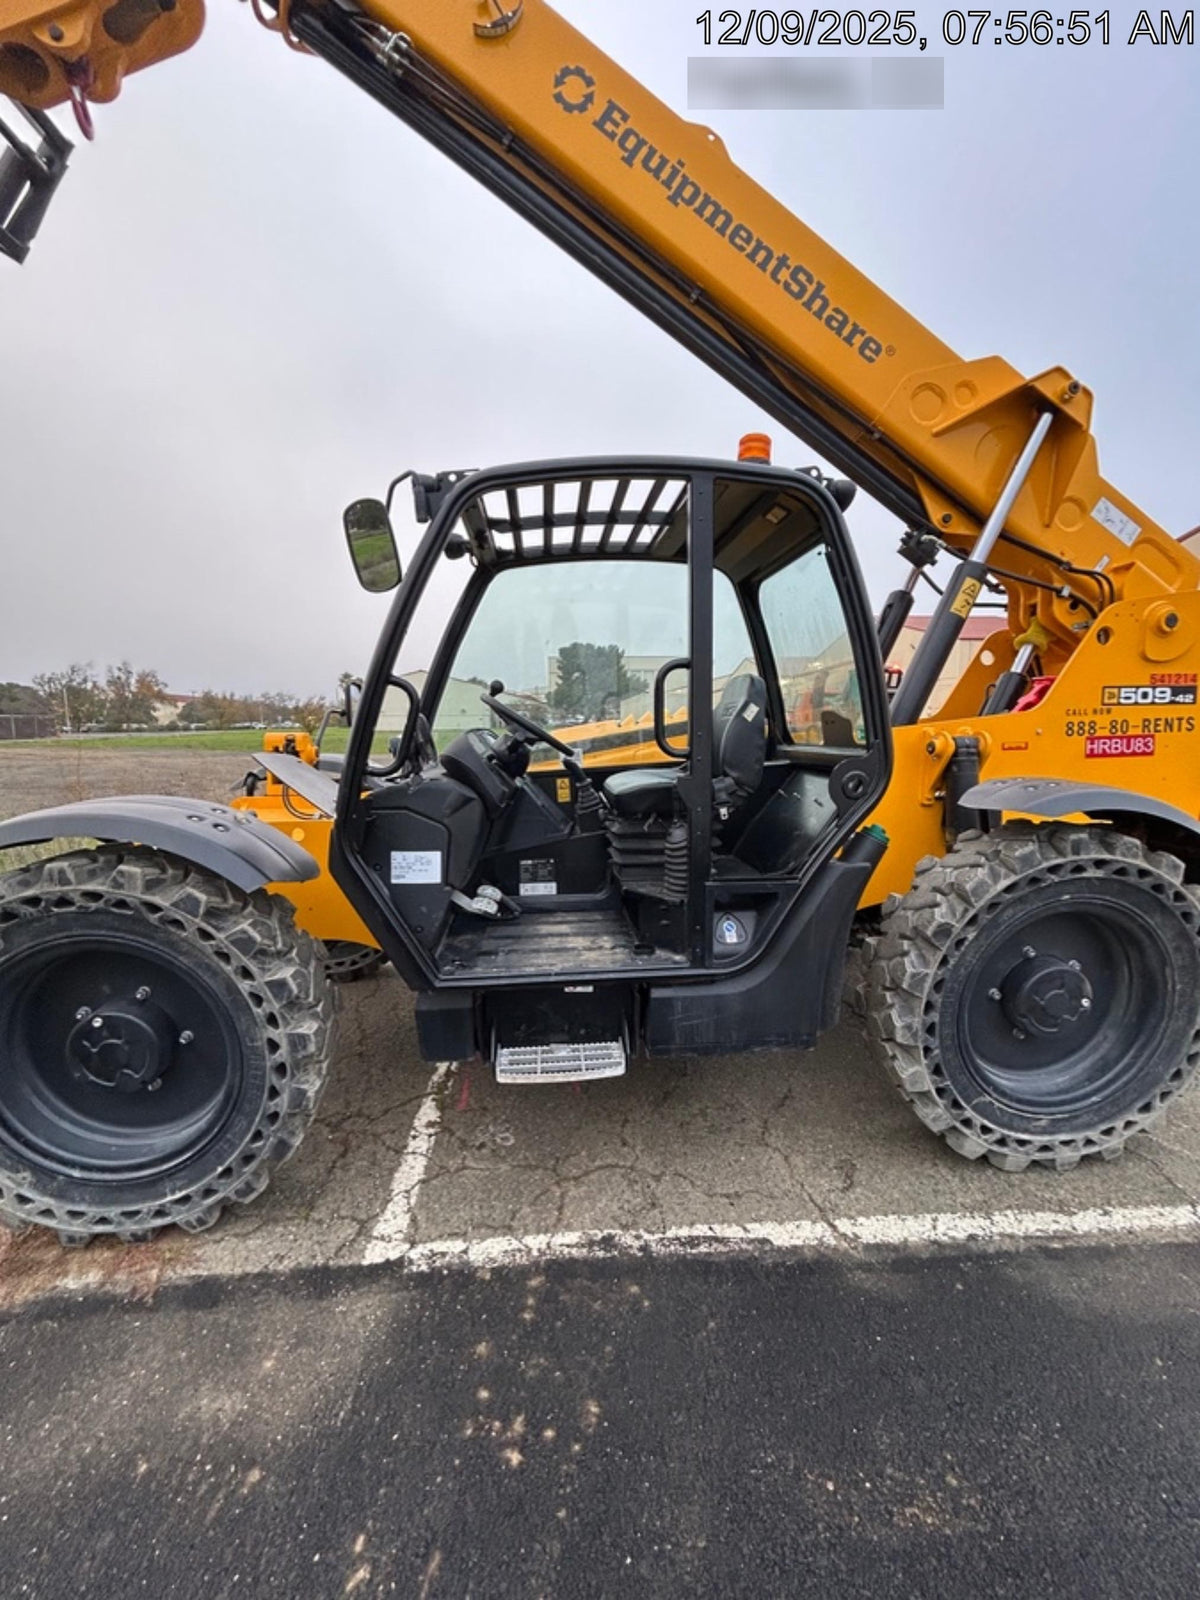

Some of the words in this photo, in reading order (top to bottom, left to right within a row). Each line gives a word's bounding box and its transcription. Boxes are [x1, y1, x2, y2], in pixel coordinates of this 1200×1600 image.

[1065, 708, 1088, 716] CALL
[1092, 707, 1112, 715] NOW
[1066, 716, 1195, 736] 888-80-RENTS
[1086, 738, 1153, 754] HRBU83
